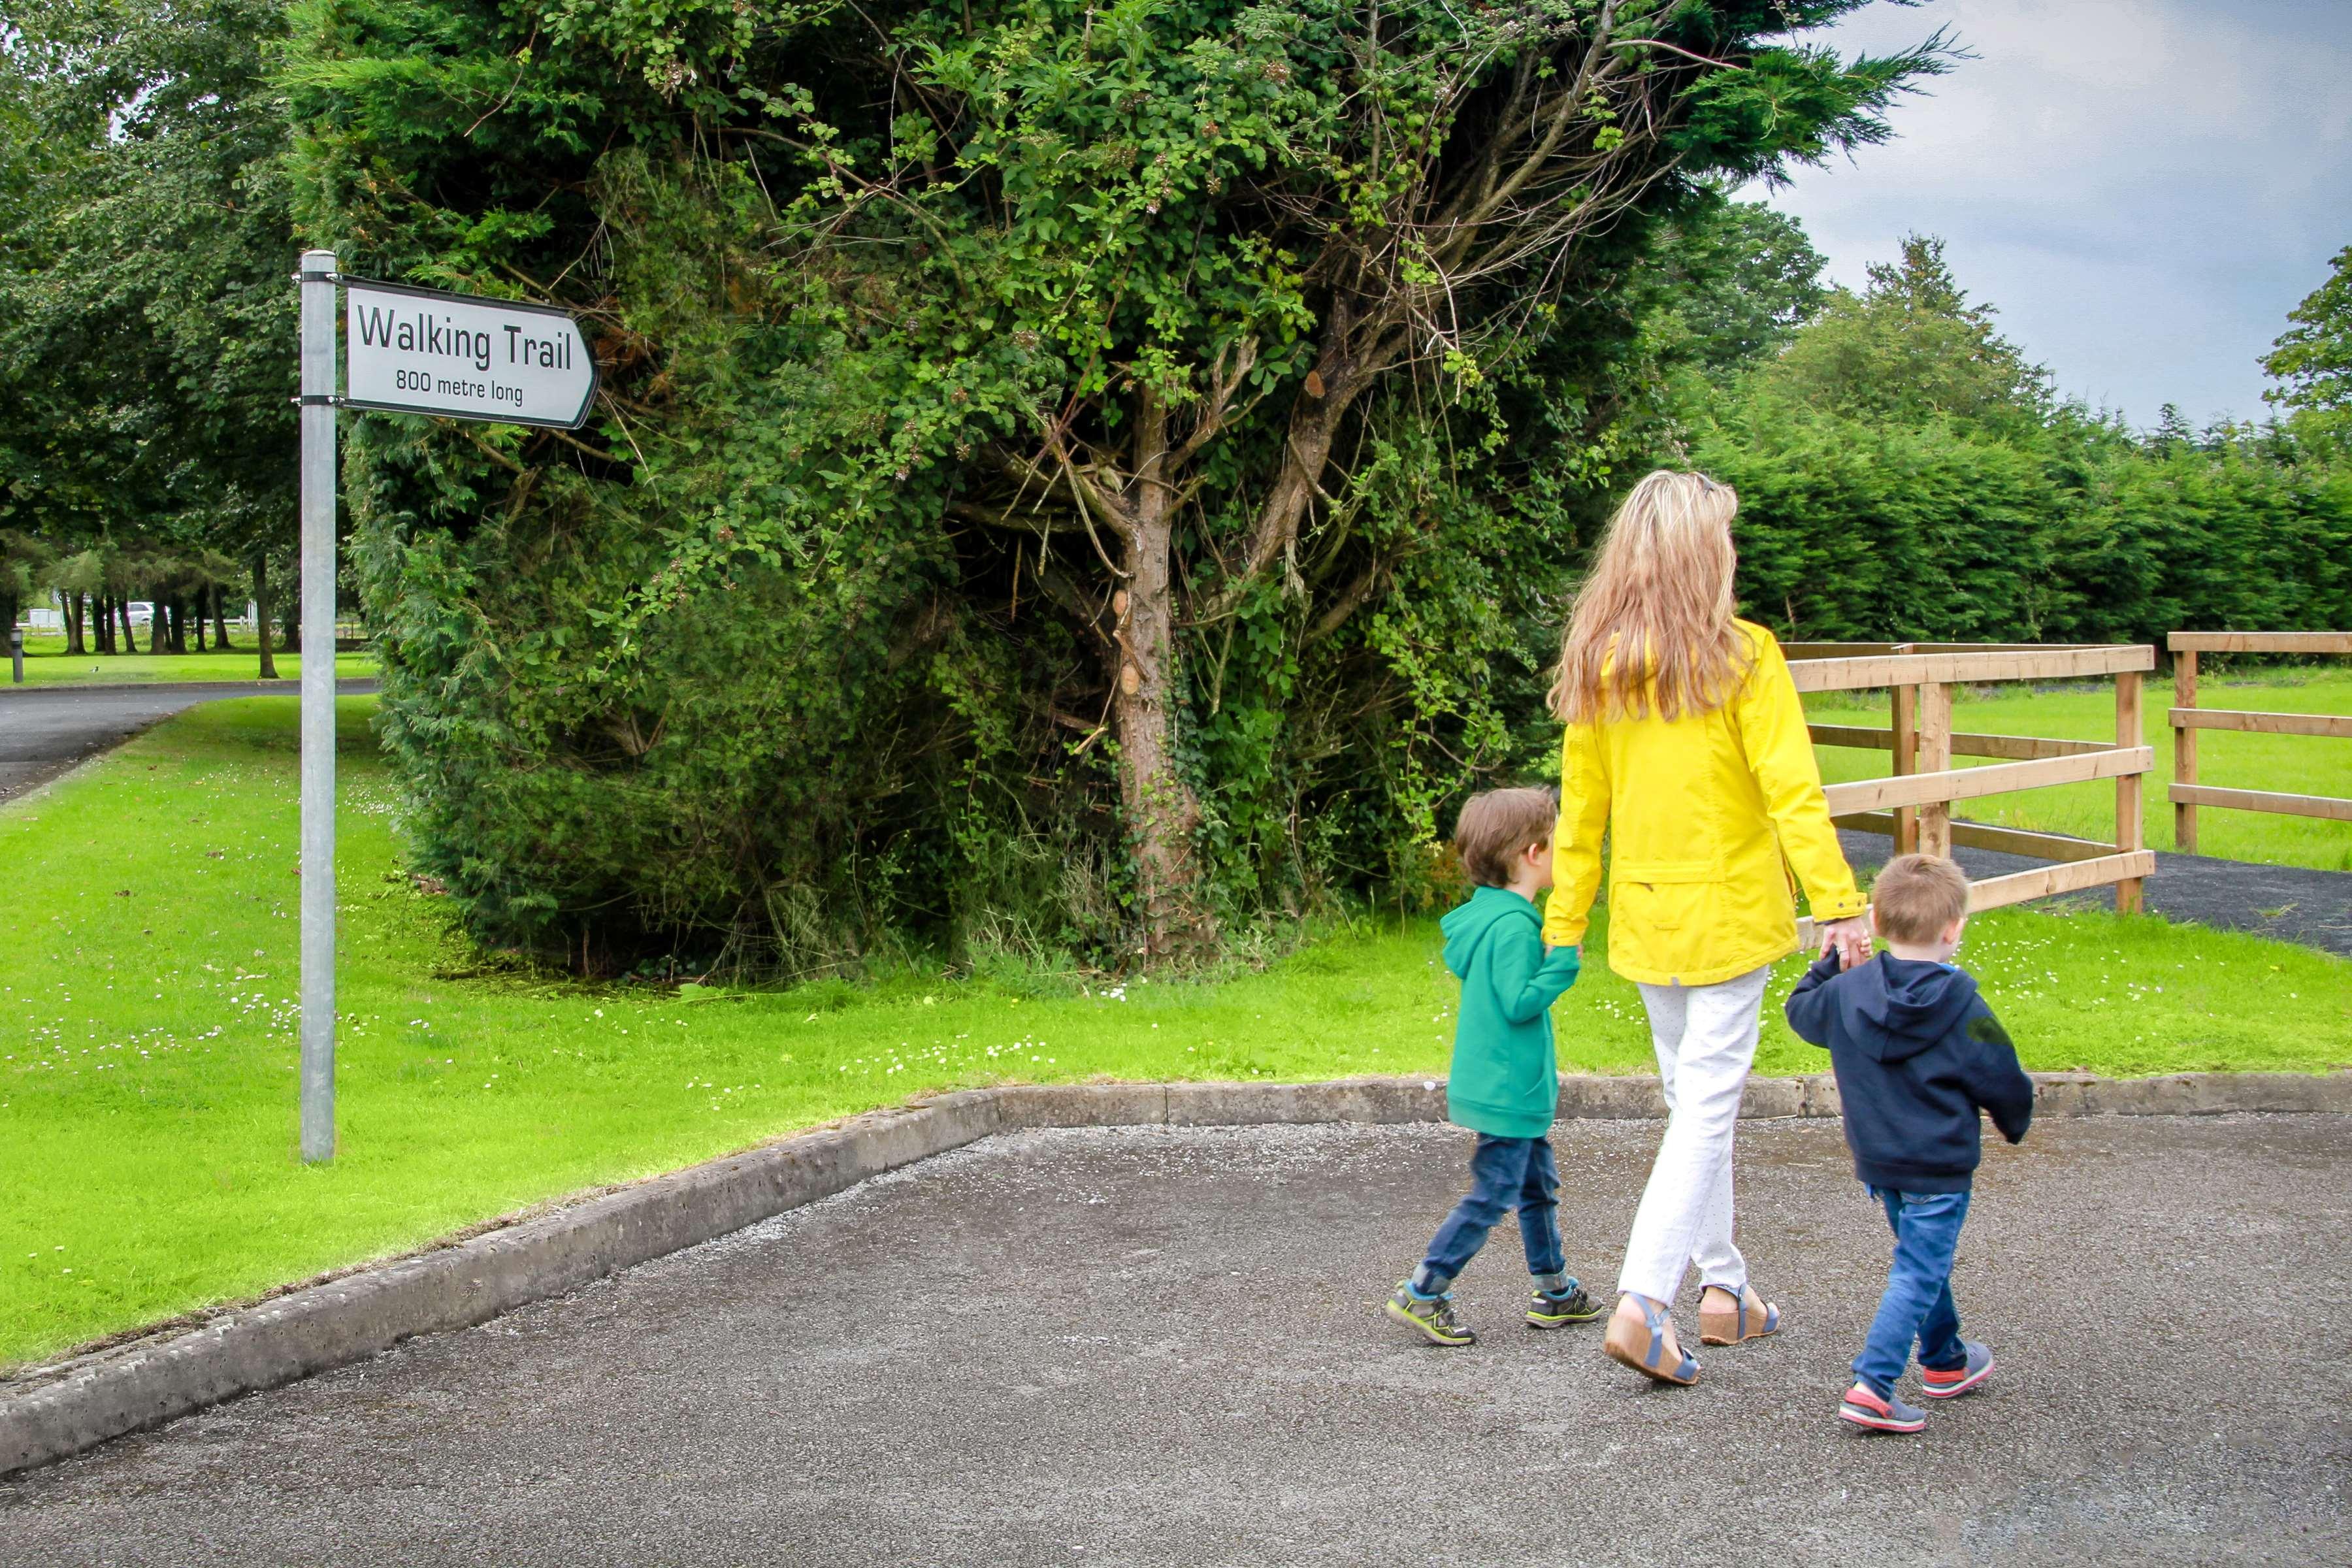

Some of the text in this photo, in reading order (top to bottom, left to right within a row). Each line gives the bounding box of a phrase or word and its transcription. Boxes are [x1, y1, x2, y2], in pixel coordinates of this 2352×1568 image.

[357, 304, 572, 371] Walking Trail
[396, 369, 523, 408] 800 metre long
